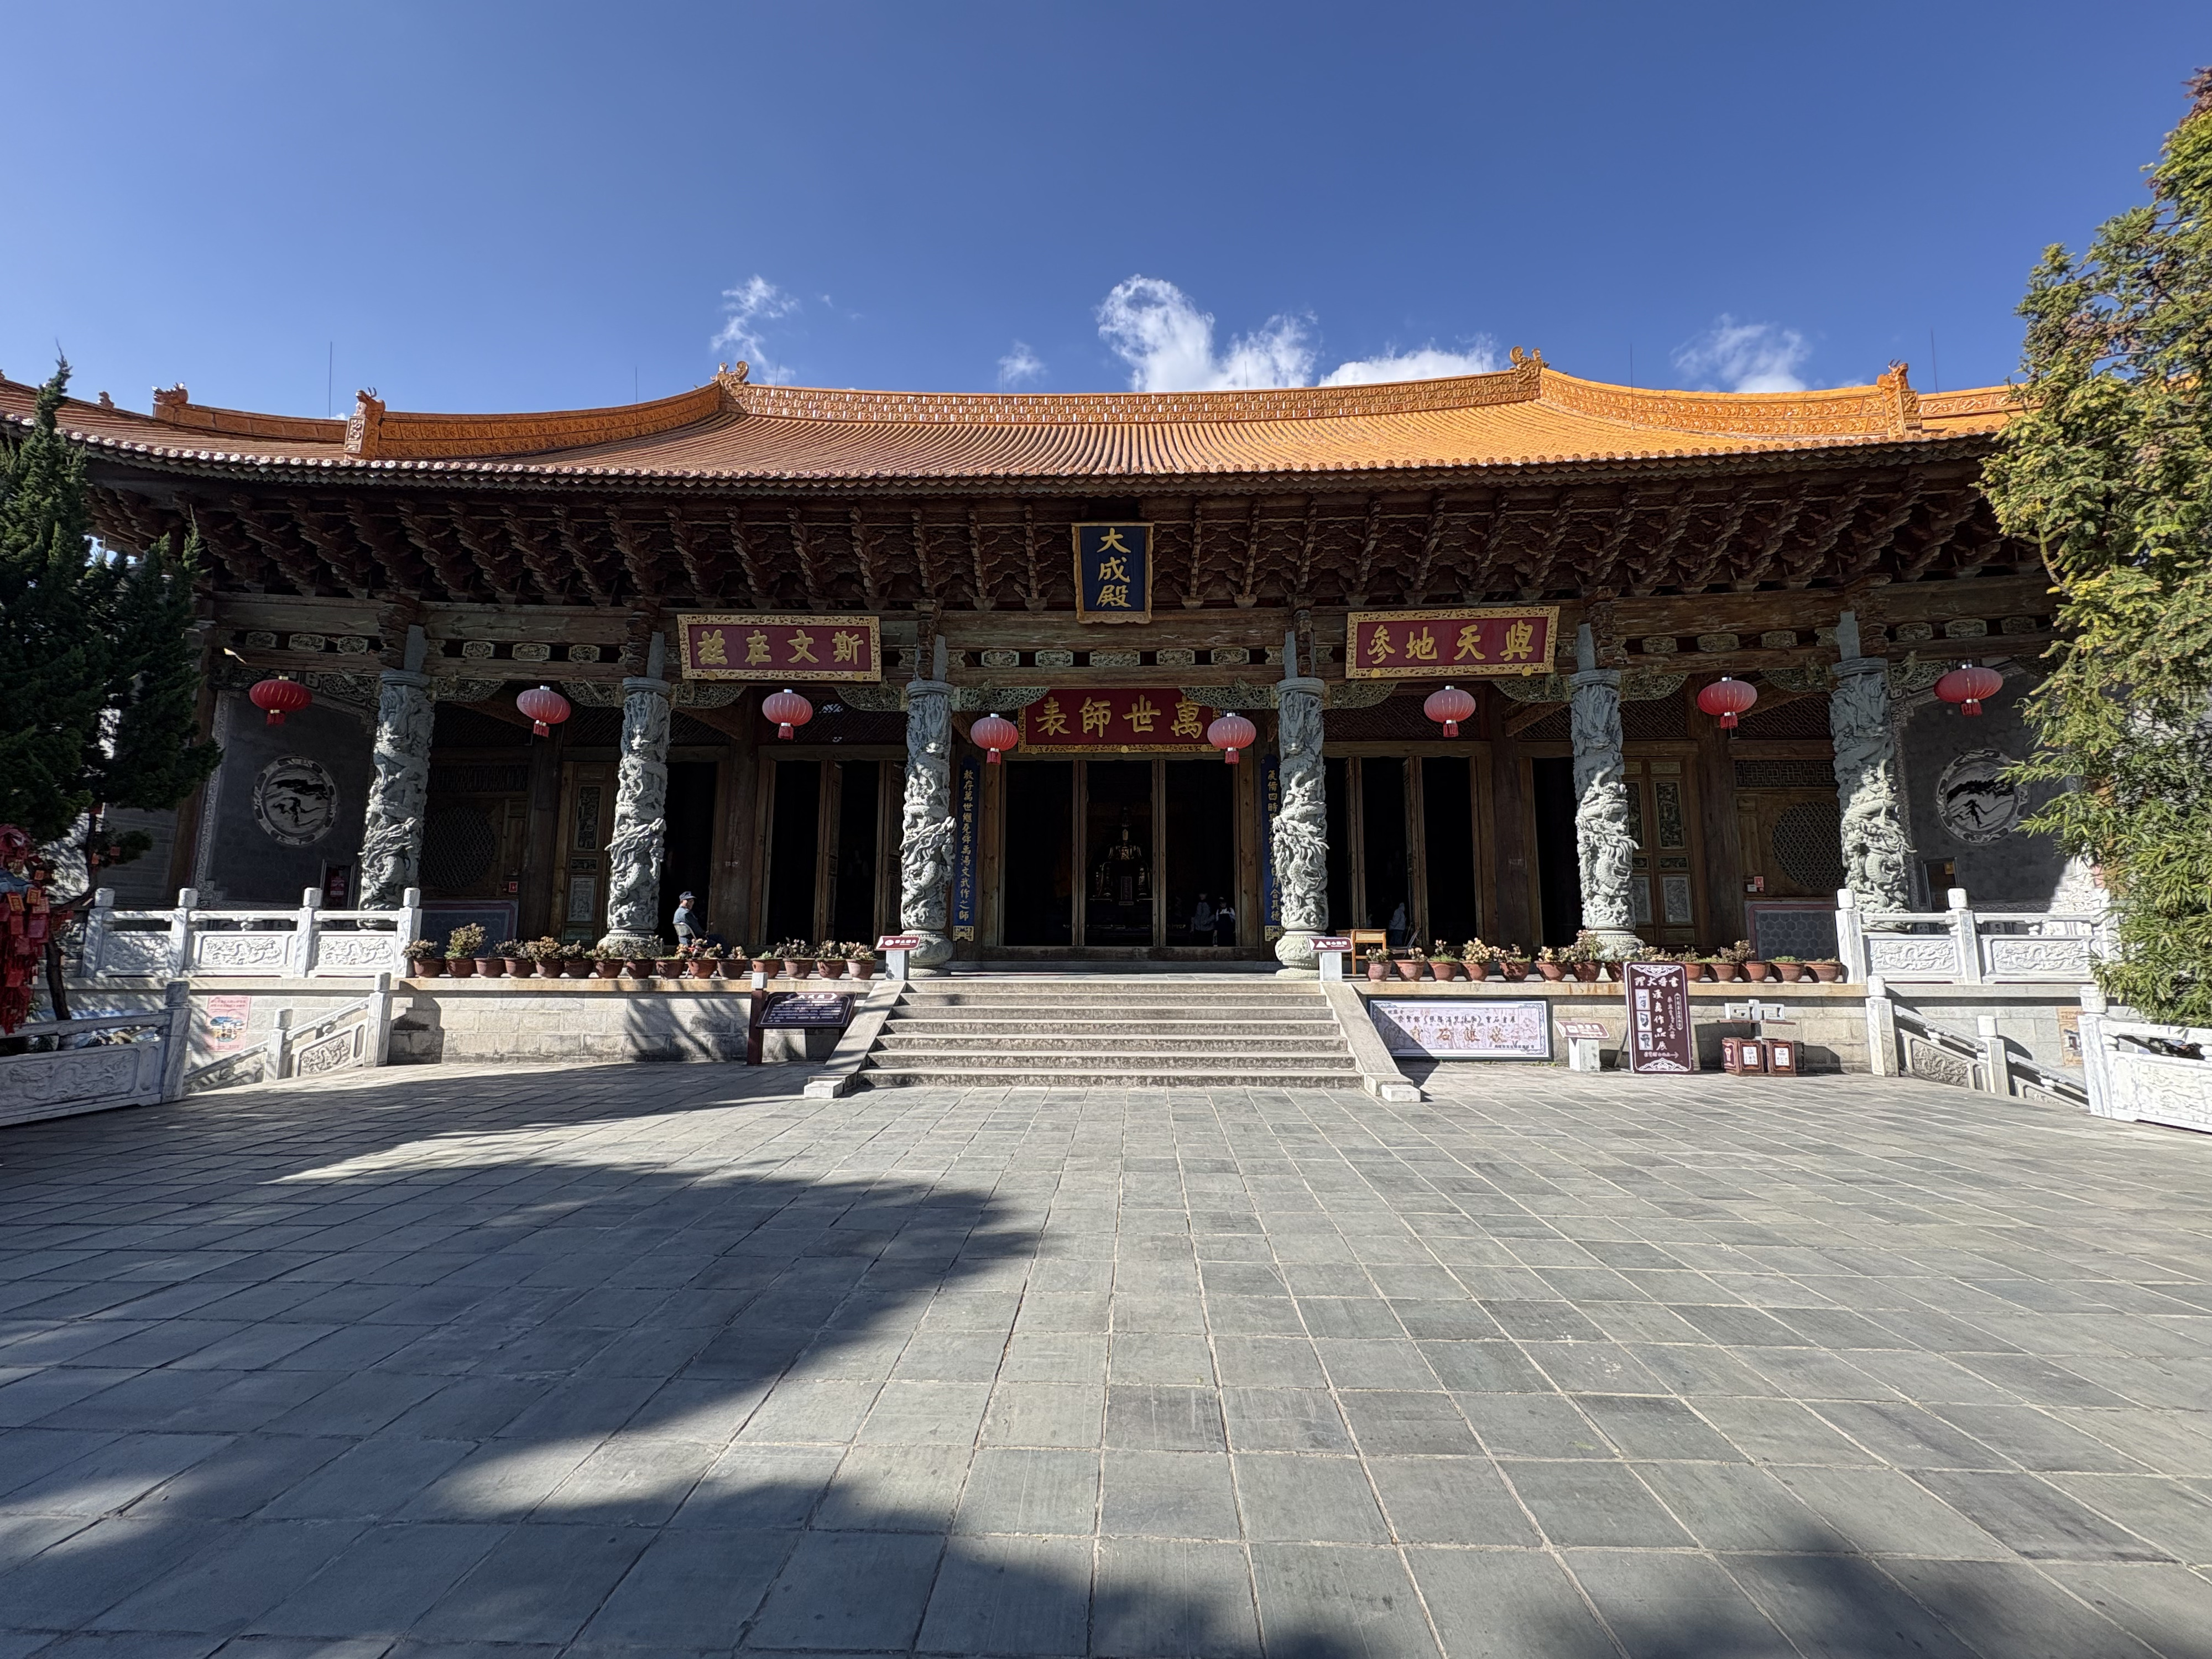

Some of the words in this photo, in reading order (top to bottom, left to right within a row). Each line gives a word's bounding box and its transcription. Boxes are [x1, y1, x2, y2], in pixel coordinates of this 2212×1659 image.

[1096, 527, 1132, 608] 大成殿
[1035, 694, 1204, 739] 萬世師表
